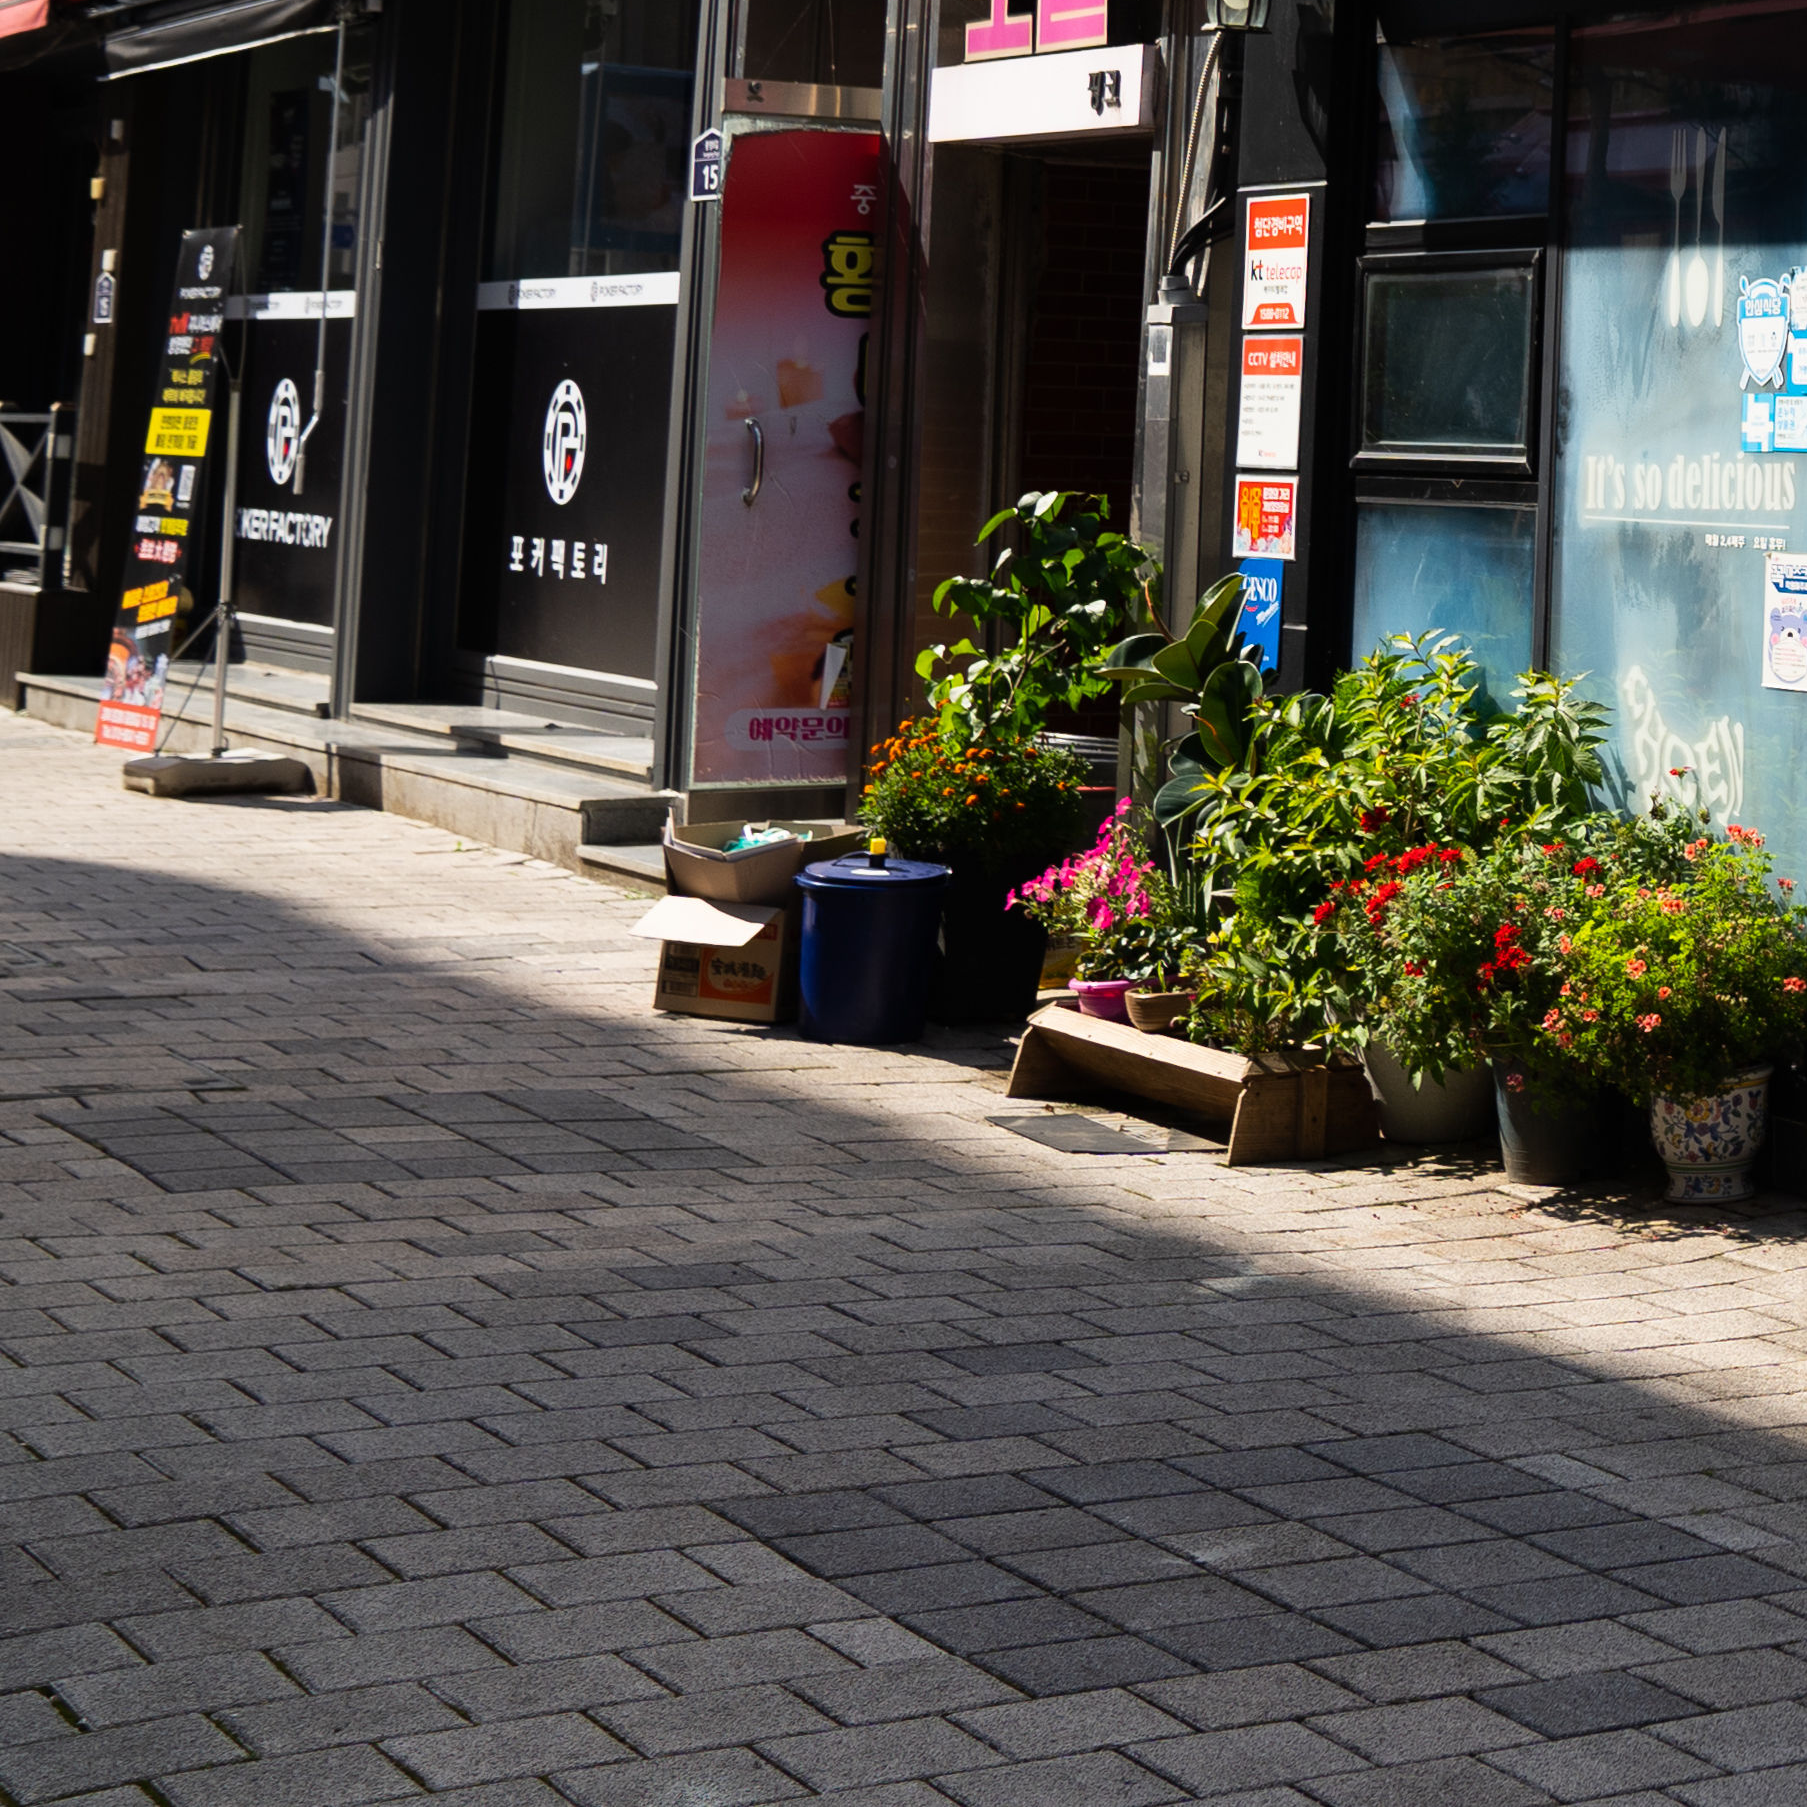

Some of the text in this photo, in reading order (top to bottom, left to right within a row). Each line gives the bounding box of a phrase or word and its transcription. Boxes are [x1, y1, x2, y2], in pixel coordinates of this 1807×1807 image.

[703, 165, 718, 190] 15
[1254, 214, 1303, 238] 첨단경비구역
[1251, 259, 1302, 284] kt telecop
[1248, 352, 1268, 367] CCTV
[1634, 462, 1663, 511] so
[1668, 451, 1796, 511] delicious
[509, 535, 608, 584] 포커팩토리
